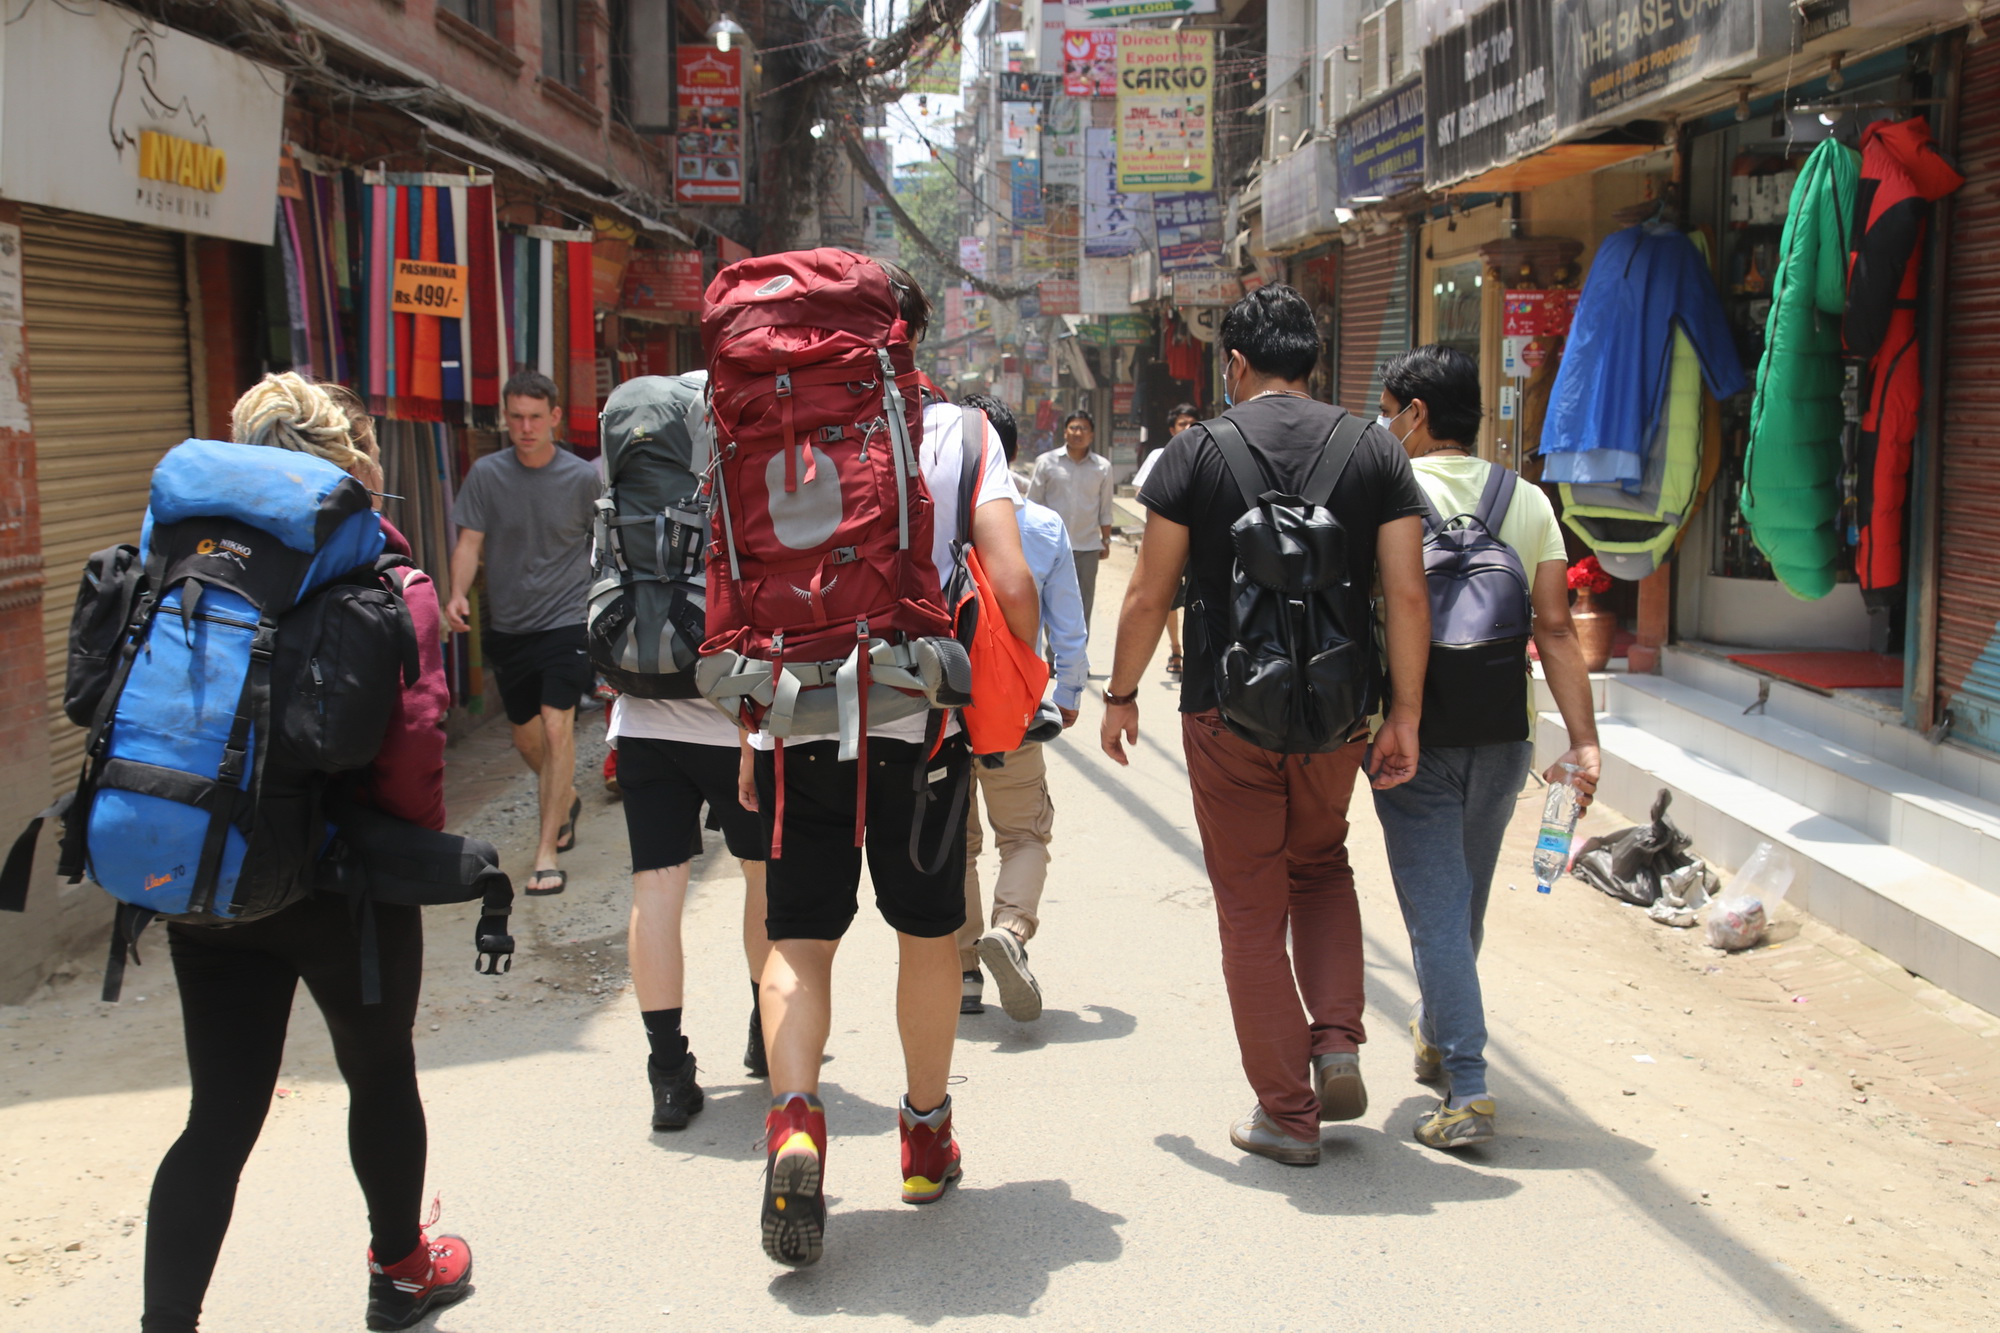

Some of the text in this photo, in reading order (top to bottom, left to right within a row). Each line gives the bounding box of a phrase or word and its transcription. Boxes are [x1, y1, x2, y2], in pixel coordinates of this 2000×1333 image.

[1129, 2, 1175, 14] FLOOR
[1122, 33, 1207, 47] Direct Way
[1581, 0, 1674, 69] THE BASE
[1126, 52, 1204, 65] Exporters
[1464, 26, 1514, 83] ROOF TOP
[1650, 34, 1701, 70] PRODUCT
[1122, 67, 1207, 90] CARGO
[1437, 112, 1456, 147] SKY
[1525, 66, 1545, 107] BAR
[141, 131, 226, 194] NYANO
[400, 263, 457, 279] PASHMINA
[671, 521, 682, 549] GUID
[220, 539, 252, 556] NIKKO
[172, 864, 185, 880] 70
